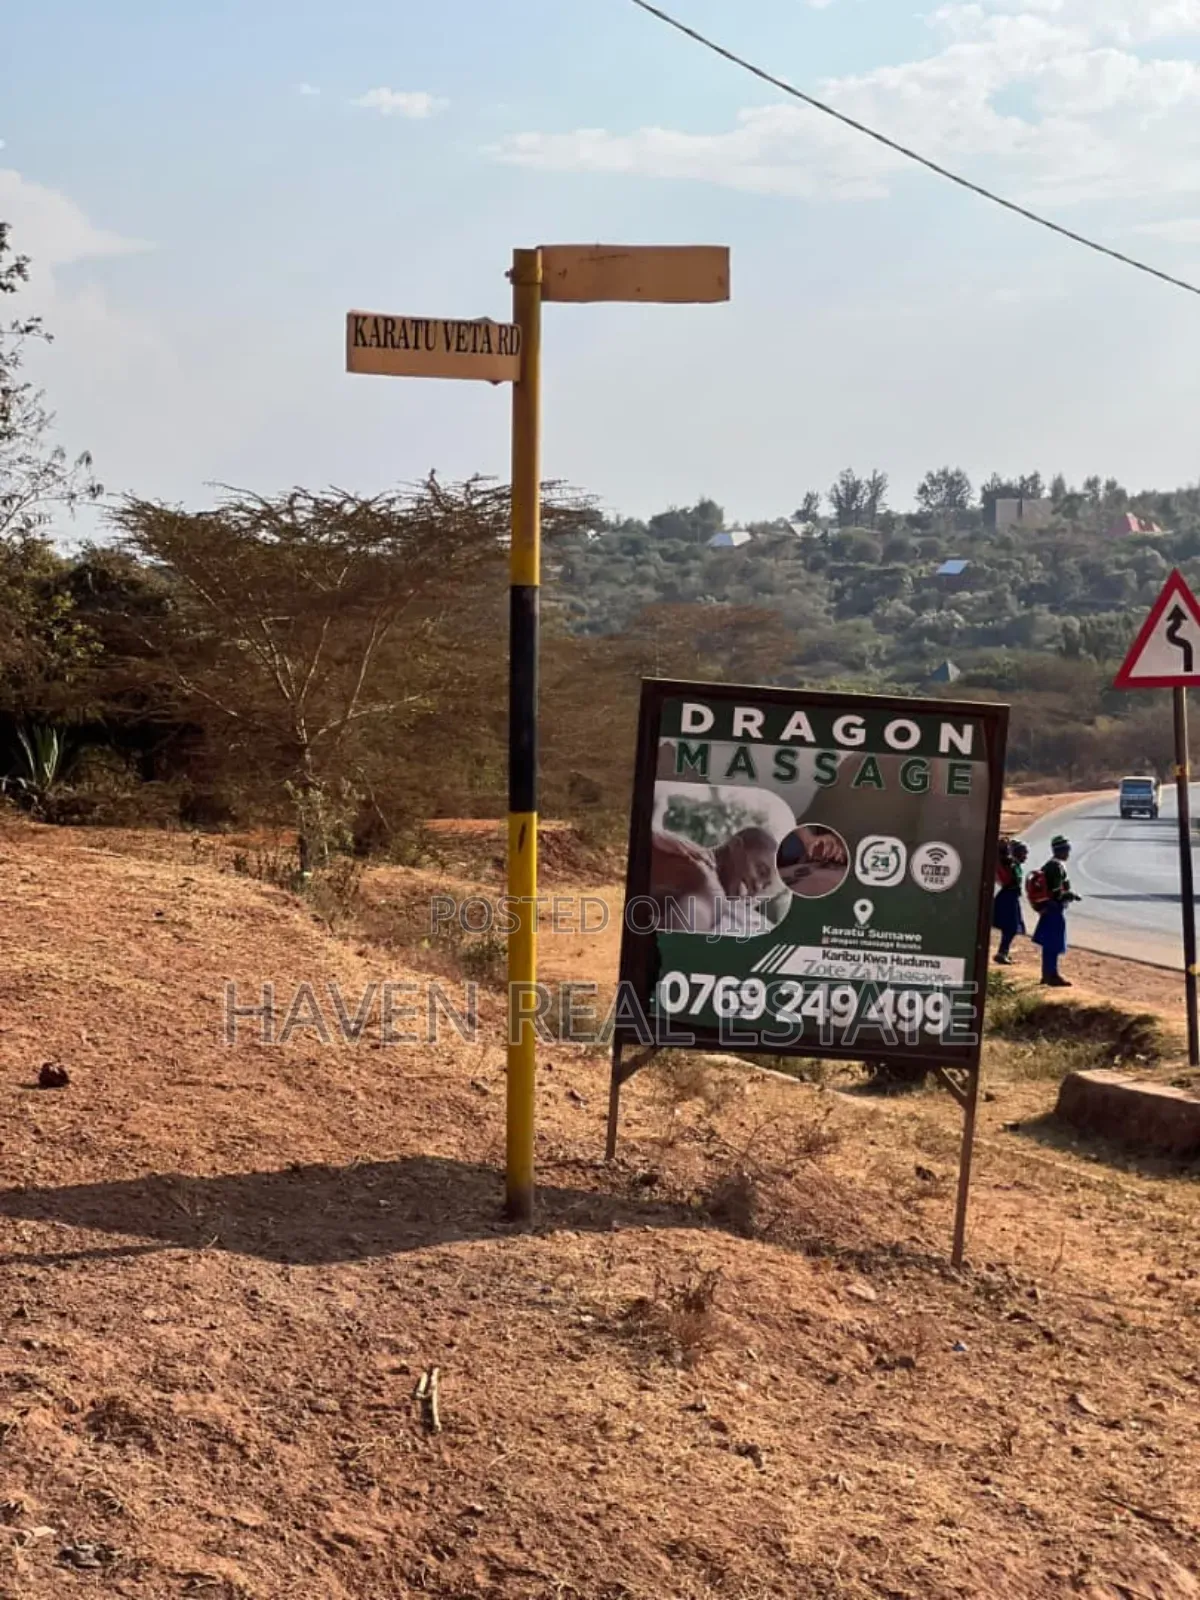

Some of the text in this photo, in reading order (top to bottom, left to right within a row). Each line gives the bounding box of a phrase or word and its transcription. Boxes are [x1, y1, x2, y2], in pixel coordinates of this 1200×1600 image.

[353, 315, 521, 356] KARATU VETA RD
[680, 703, 974, 755] DRAGON
[675, 742, 973, 795] MASSAGE
[822, 925, 865, 937] Karatu
[803, 960, 846, 976] Zote
[821, 950, 941, 969] Karibu Kwa Huduma
[661, 971, 951, 1035] 0769 249 499
